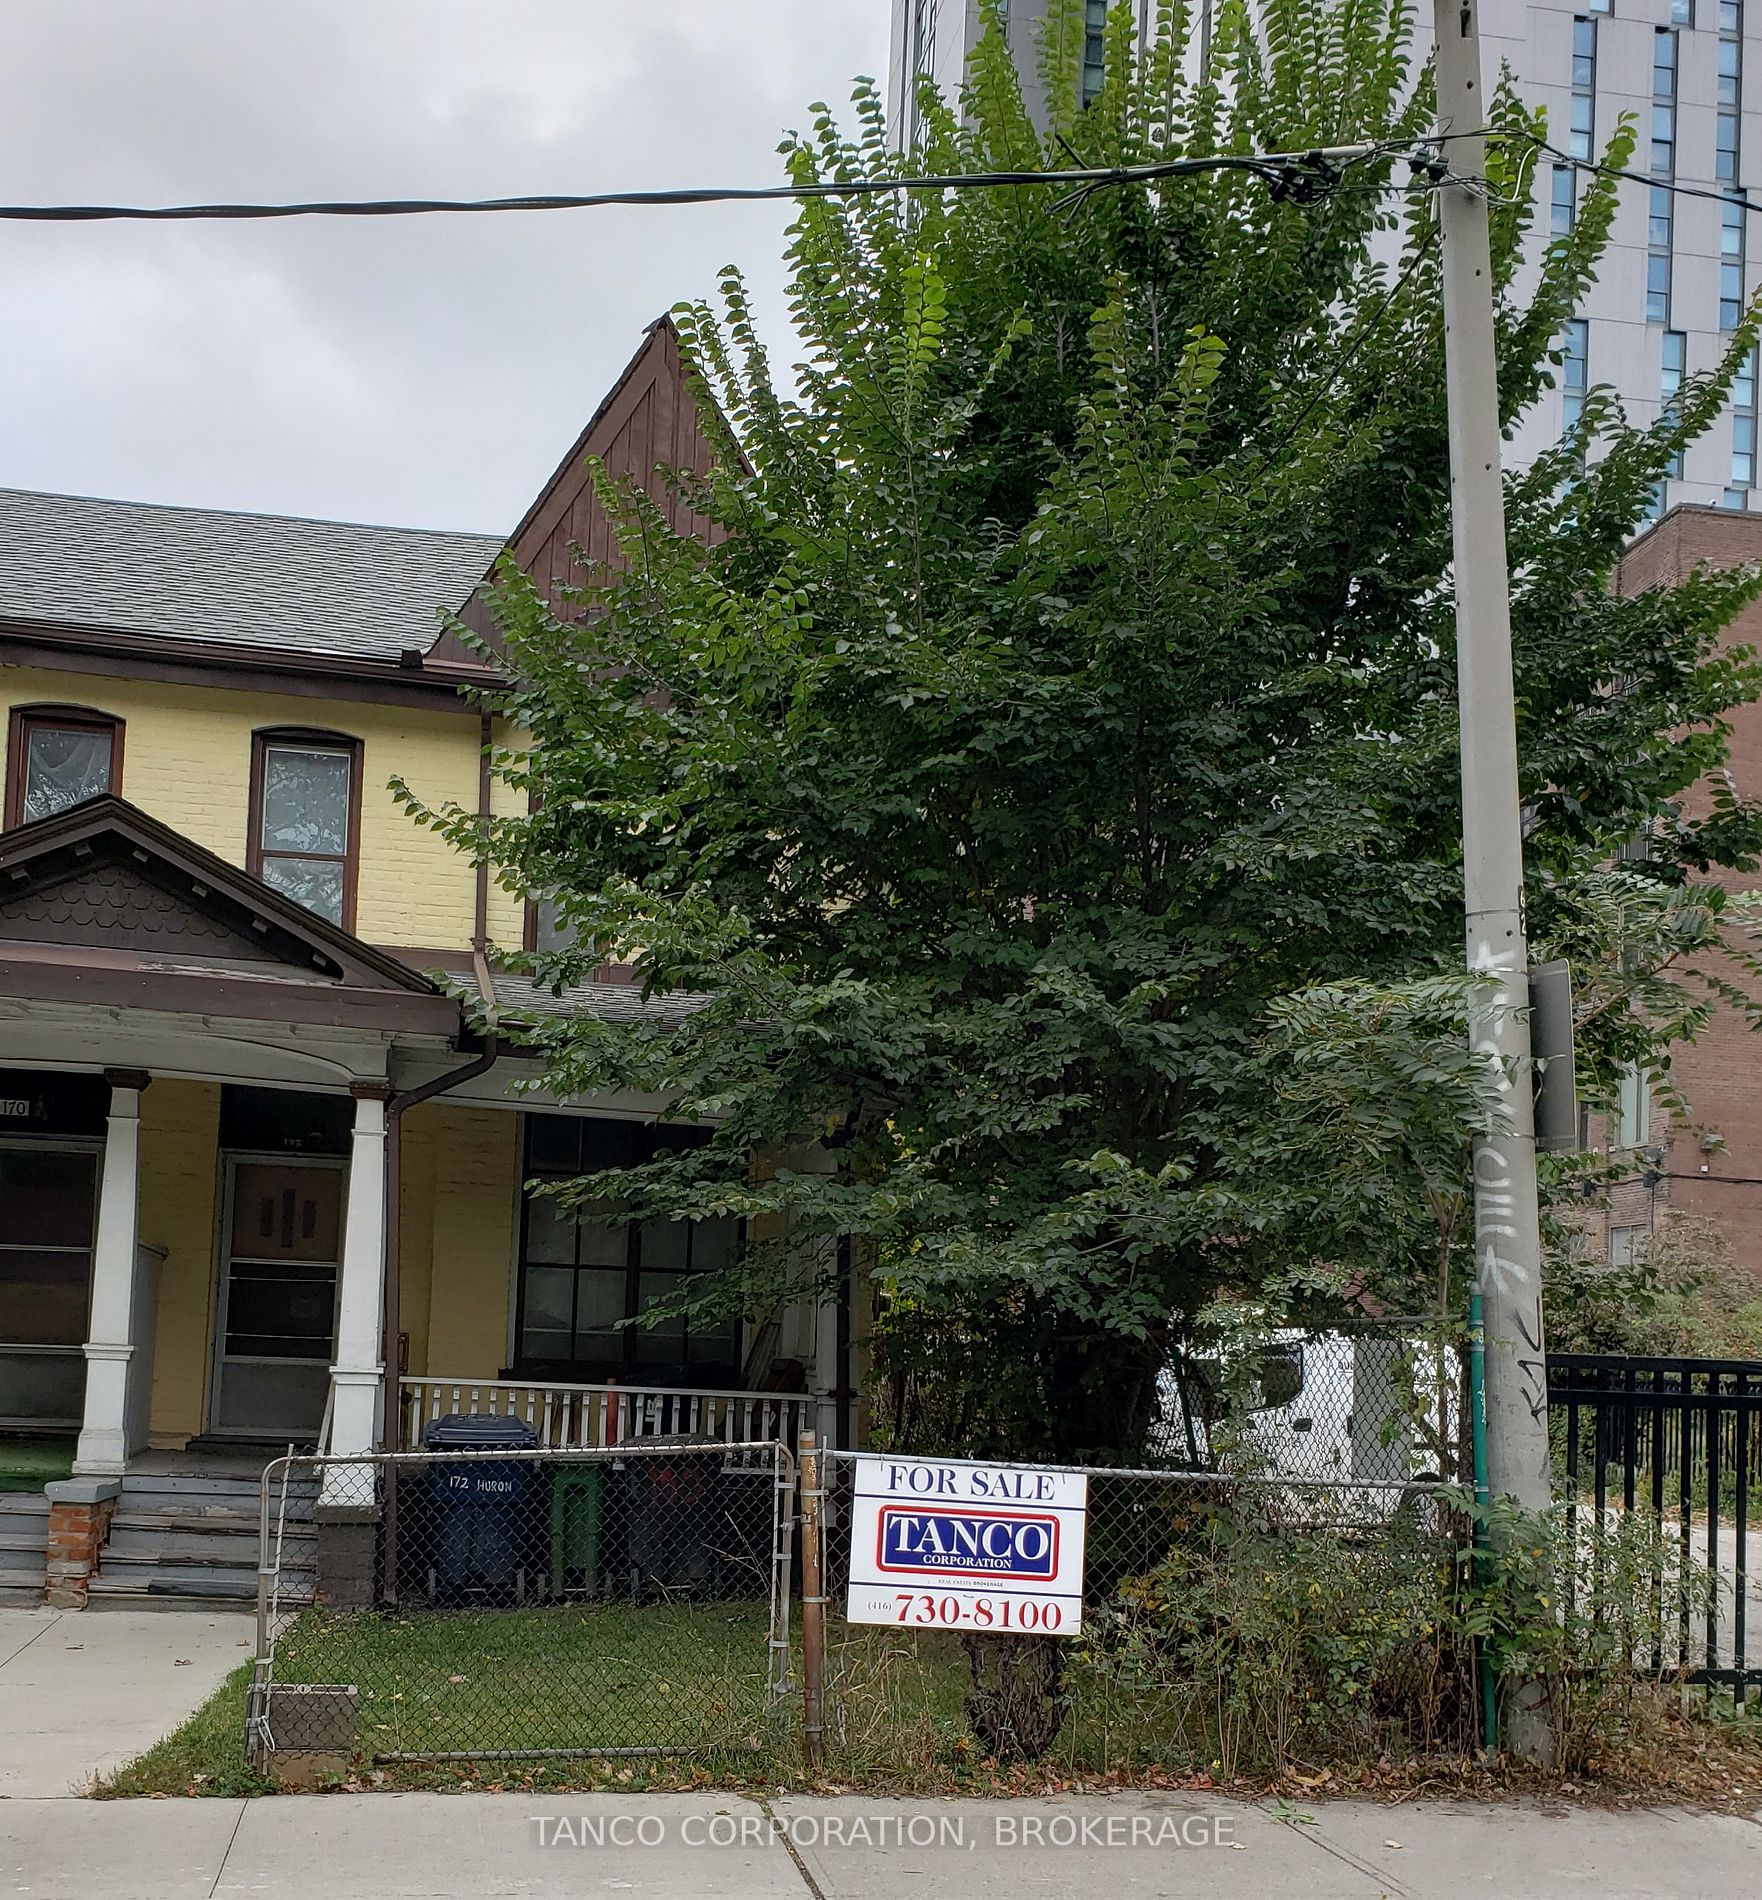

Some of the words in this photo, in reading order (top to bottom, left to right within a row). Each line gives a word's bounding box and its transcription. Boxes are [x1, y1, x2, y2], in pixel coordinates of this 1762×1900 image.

[3, 1101, 26, 1114] 170
[450, 1475, 469, 1489] 172
[477, 1479, 512, 1492] HURON
[888, 1465, 958, 1495] FOR
[970, 1470, 1056, 1501] SALE
[889, 1515, 1049, 1560] TANCO
[923, 1554, 1012, 1569] CORPORATION
[867, 1601, 892, 1612] (416)
[896, 1594, 1062, 1631] 730-8100
